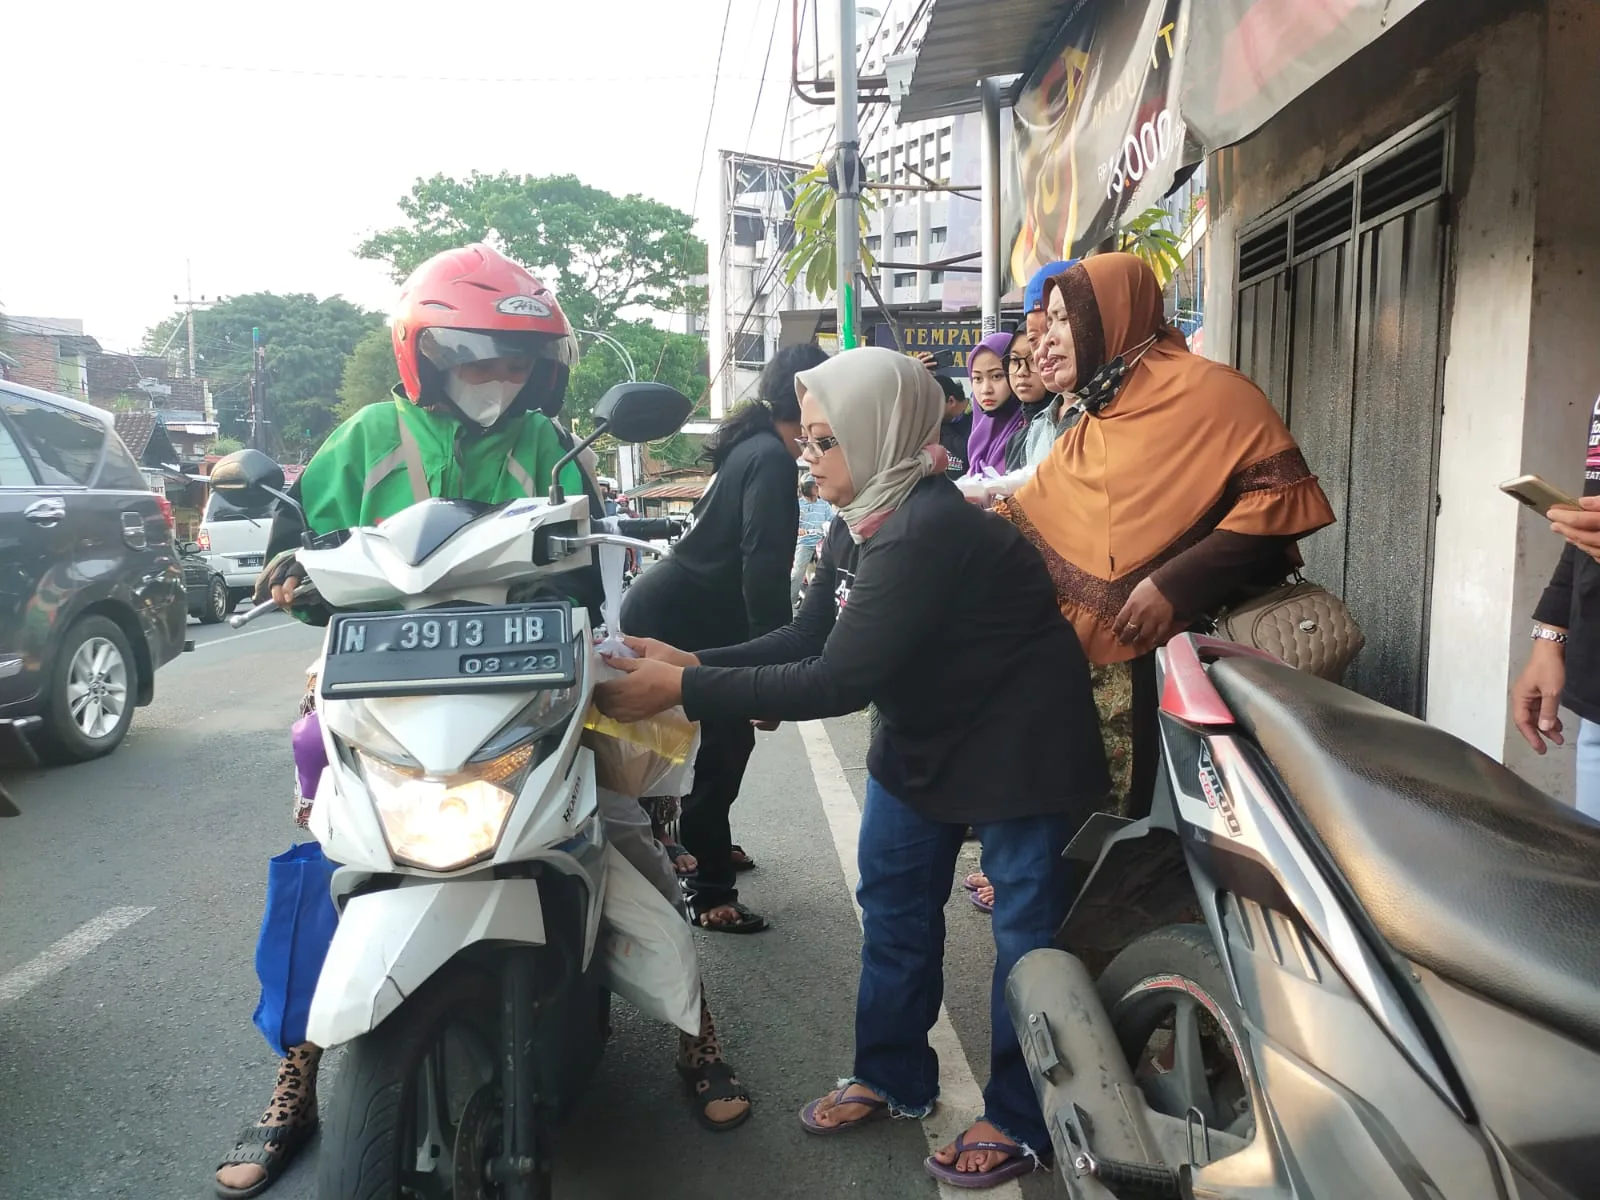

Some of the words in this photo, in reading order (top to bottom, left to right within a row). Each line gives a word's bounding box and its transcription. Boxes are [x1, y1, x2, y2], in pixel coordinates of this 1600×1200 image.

[904, 328, 983, 345] TEMPAT
[344, 626, 366, 652] N
[401, 620, 484, 649] 3913
[504, 616, 544, 645] HB
